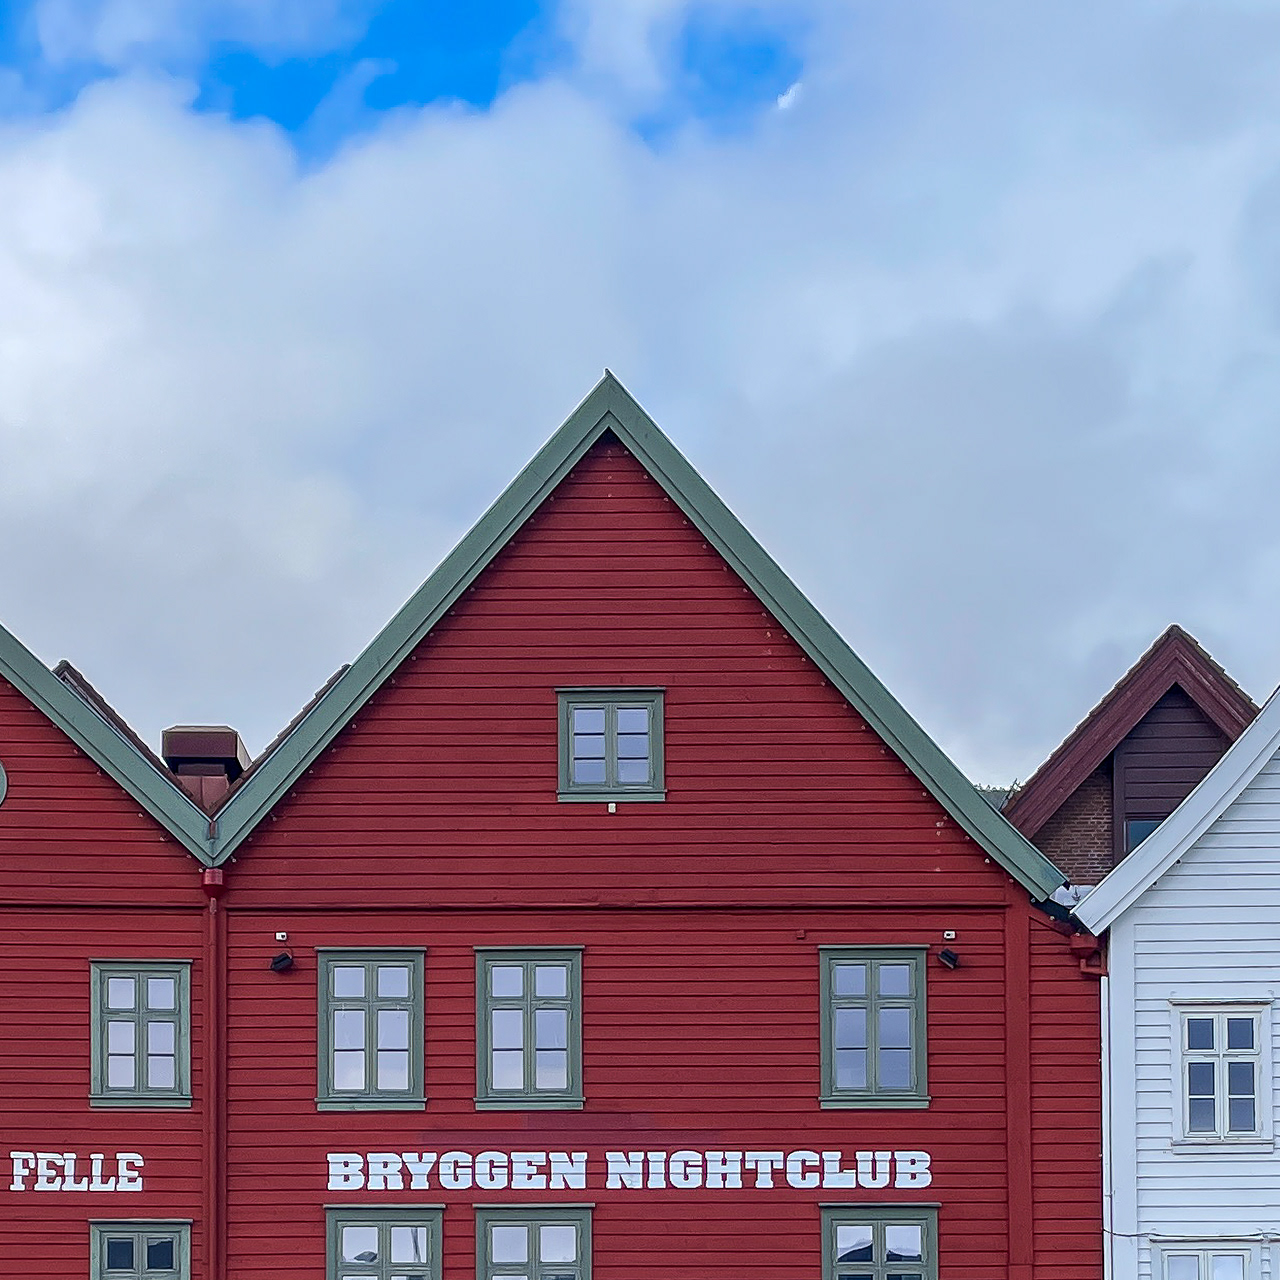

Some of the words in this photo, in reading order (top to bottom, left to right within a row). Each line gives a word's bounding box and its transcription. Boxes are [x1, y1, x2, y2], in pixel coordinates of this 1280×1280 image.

[9, 1151, 146, 1192] FELLE
[325, 1151, 589, 1192] BRYGGEN
[606, 1149, 934, 1191] NIGHTCLUB
